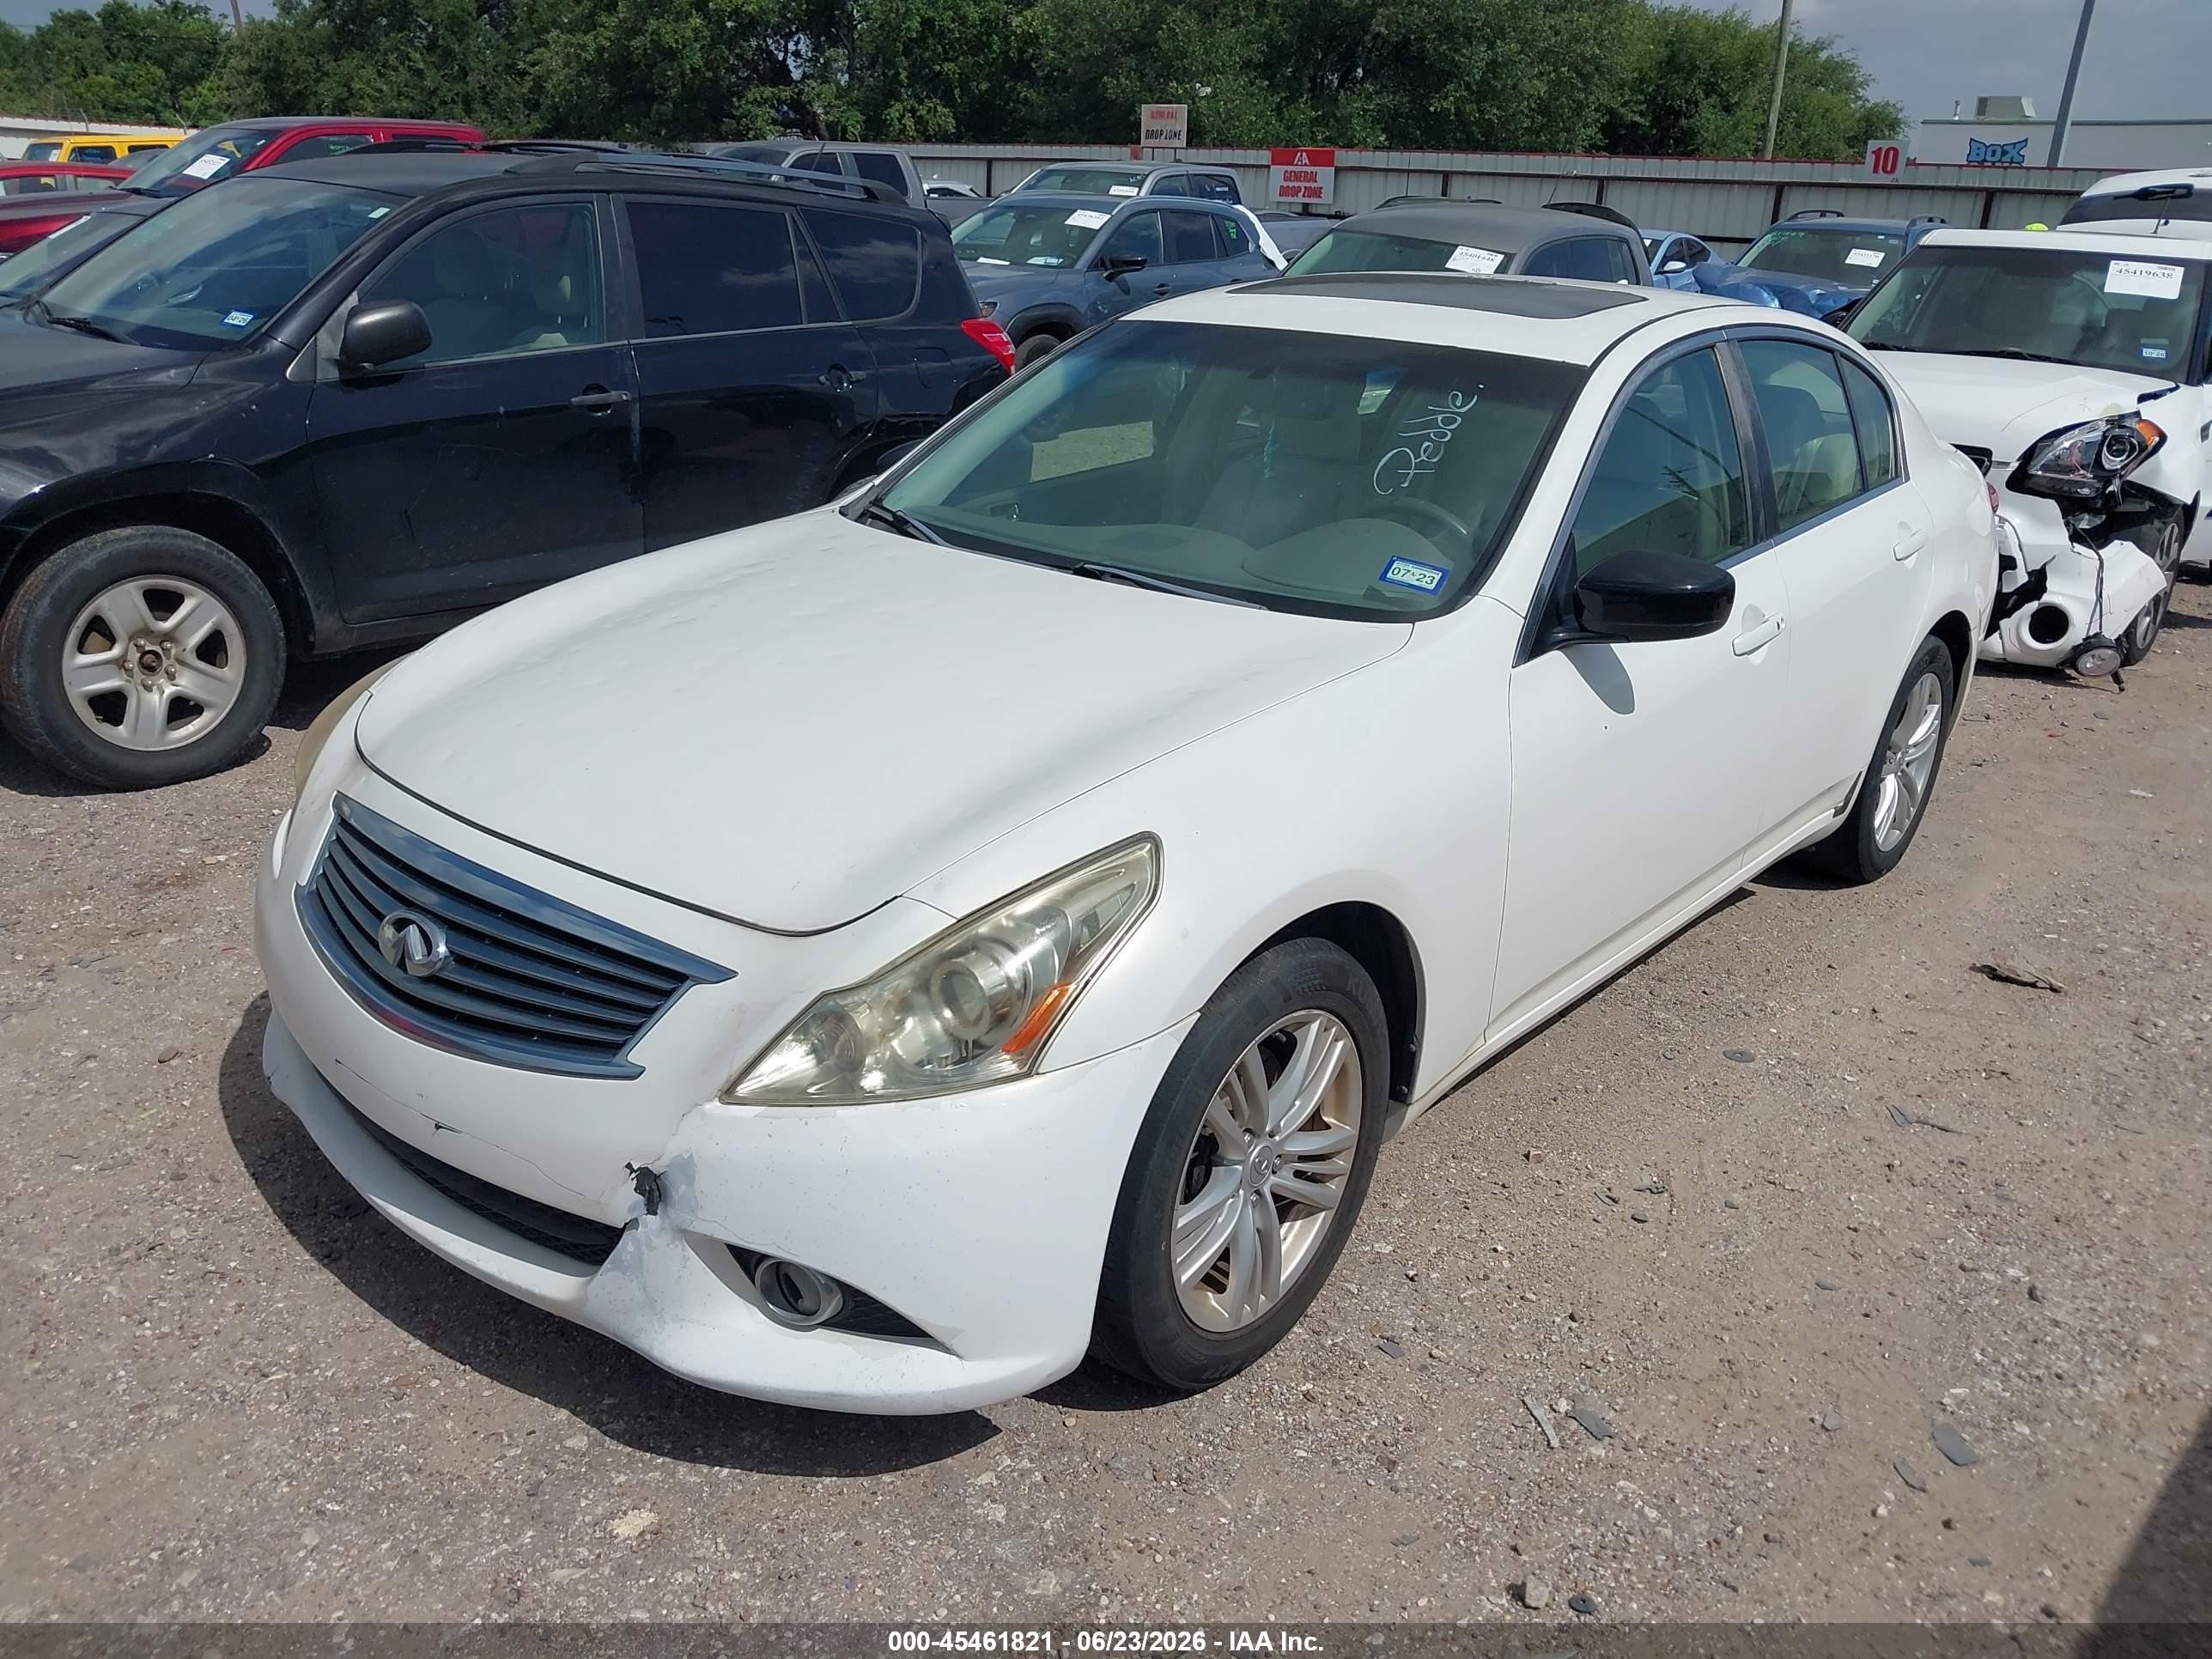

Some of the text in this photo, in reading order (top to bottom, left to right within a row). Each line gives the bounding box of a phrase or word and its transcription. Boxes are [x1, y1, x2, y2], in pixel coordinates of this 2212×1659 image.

[1145, 129, 1182, 141] DROP ZONE
[1966, 137, 2028, 164] BOX
[1871, 146, 1899, 174] 10
[1283, 170, 1318, 183] GENERAL
[1279, 185, 1324, 199] DROP ZONE
[2115, 267, 2174, 280] 45419638
